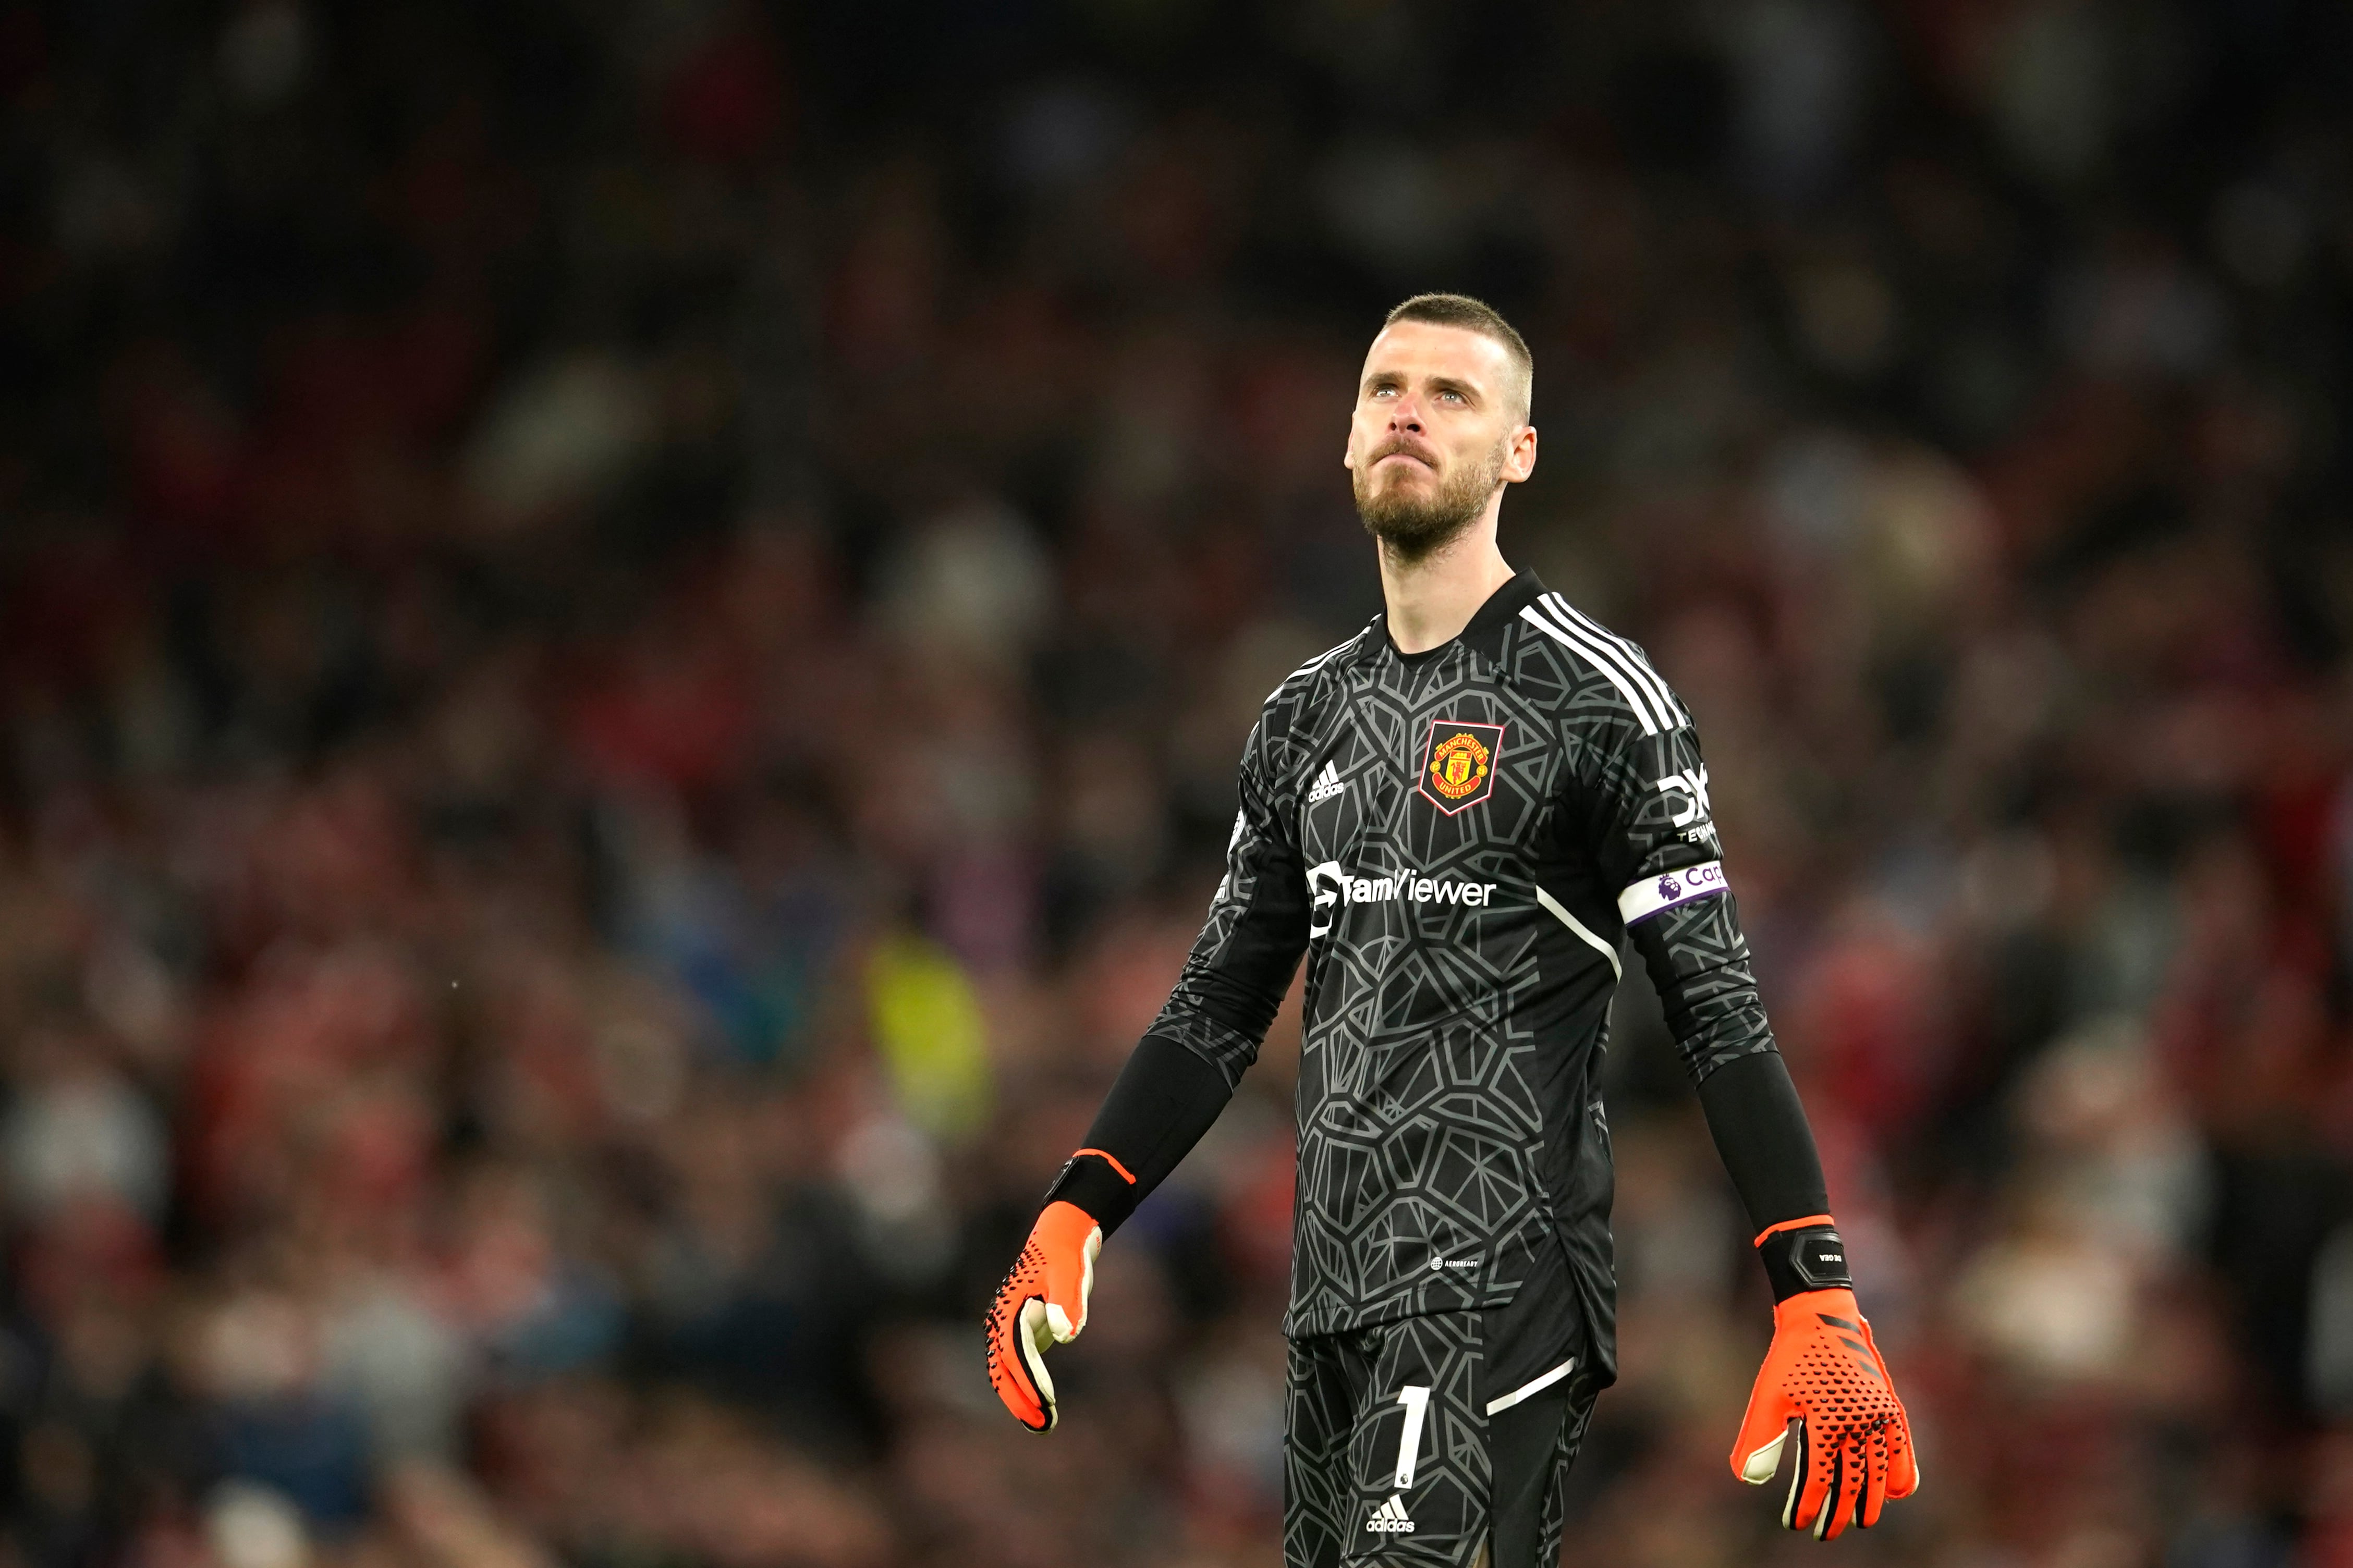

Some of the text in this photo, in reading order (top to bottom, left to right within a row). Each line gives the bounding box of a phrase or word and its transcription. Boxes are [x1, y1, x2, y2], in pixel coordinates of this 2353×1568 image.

[1439, 738, 1484, 761] MANCHESTER
[1309, 782, 1344, 803] adidas
[1440, 782, 1471, 794] UNITED
[1657, 763, 1710, 828] DX
[1686, 866, 1722, 886] Cap
[1340, 868, 1497, 907] TamViewer
[1394, 1385, 1431, 1489] 1
[1366, 1517, 1415, 1533] adidas
